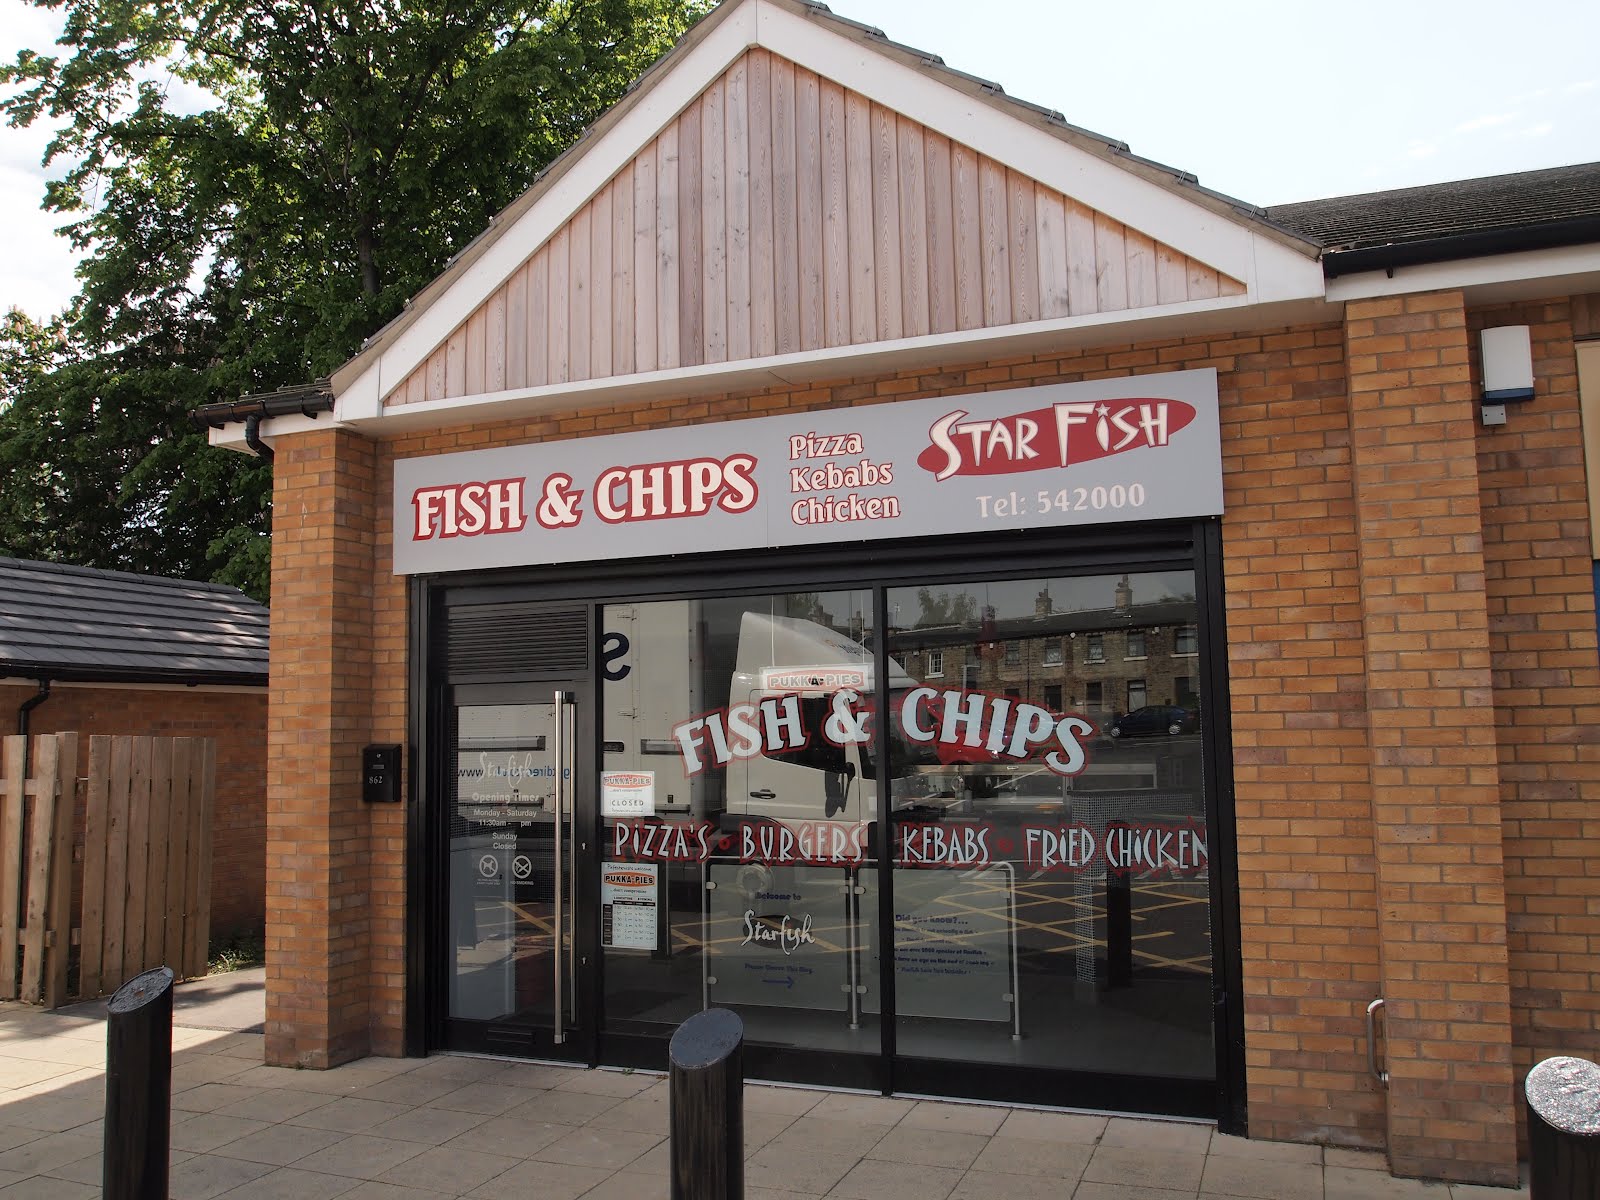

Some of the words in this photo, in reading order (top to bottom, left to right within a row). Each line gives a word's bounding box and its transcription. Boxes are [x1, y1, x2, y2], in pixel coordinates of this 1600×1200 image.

[789, 432, 864, 461] Pizza
[790, 460, 893, 492] Kebabs
[411, 477, 526, 541] FISH
[536, 473, 583, 529] &
[593, 454, 758, 524] CHIPS
[791, 495, 900, 525] Chicken
[977, 492, 1026, 519] Tel:
[1037, 483, 1146, 514] 542000
[672, 692, 809, 778] FISH
[822, 687, 874, 748] &
[899, 685, 1097, 775] CHIPS
[472, 792, 510, 804] Opening
[513, 792, 539, 802] Times
[611, 799, 644, 807] CLOSED
[474, 809, 501, 818] Monday
[507, 809, 537, 818] Saturday
[521, 819, 532, 828] pm
[492, 833, 518, 841] Sunday
[741, 822, 866, 866] BURGERS
[901, 824, 992, 867] KEBABS
[755, 891, 791, 900] Welcome
[741, 909, 815, 955] Starfish
